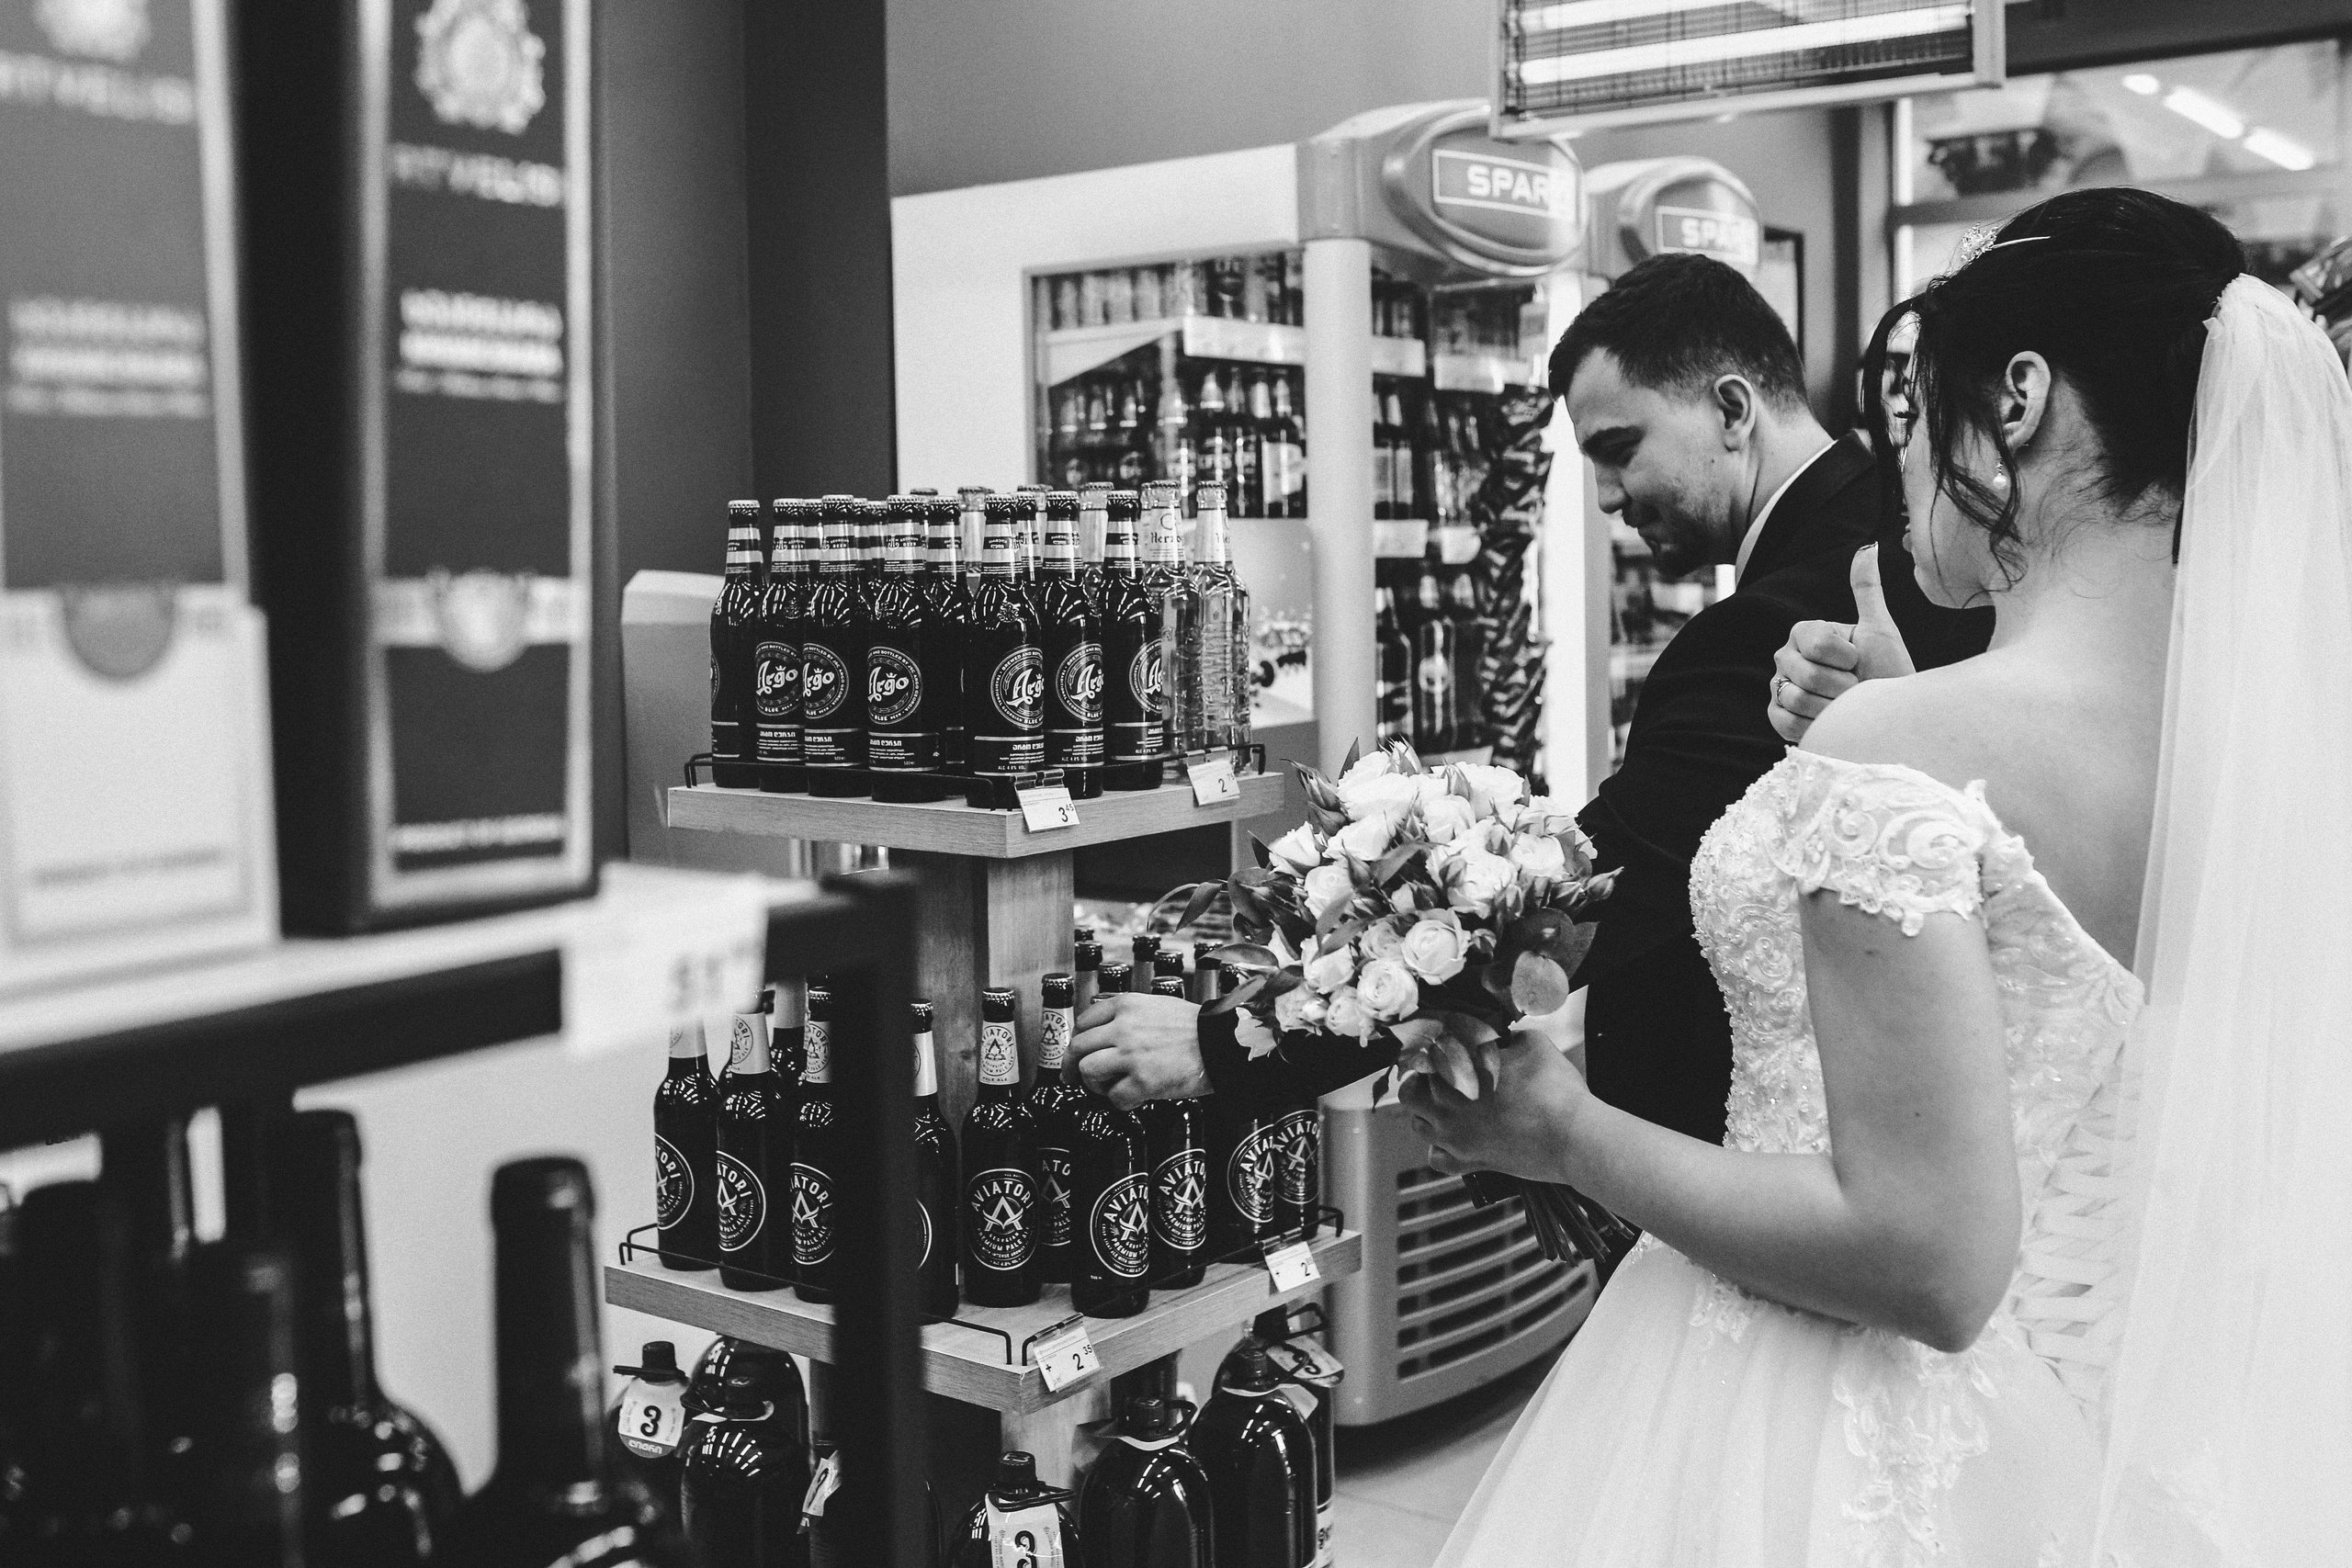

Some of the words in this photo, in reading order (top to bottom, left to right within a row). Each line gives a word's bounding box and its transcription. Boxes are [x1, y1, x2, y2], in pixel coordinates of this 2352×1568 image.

[1467, 164, 1551, 204] SPAR
[755, 660, 798, 696] Argo
[803, 661, 835, 698] Argo
[867, 666, 910, 703] Argo
[1069, 663, 1103, 699] Arg
[1218, 778, 1227, 793] 2
[1058, 807, 1069, 823] 3
[1239, 1135, 1273, 1172] AVIAT
[1272, 1121, 1321, 1154] AVIATO
[655, 1145, 681, 1179] TORI
[717, 1162, 752, 1198] ATORI
[1159, 1160, 1206, 1196] AVIATO
[971, 1180, 1035, 1213] AVIATORI
[1103, 1184, 1148, 1223] AVIATO
[1300, 1261, 1311, 1277] 2
[1072, 1352, 1085, 1371] 2
[640, 1404, 662, 1437] 3
